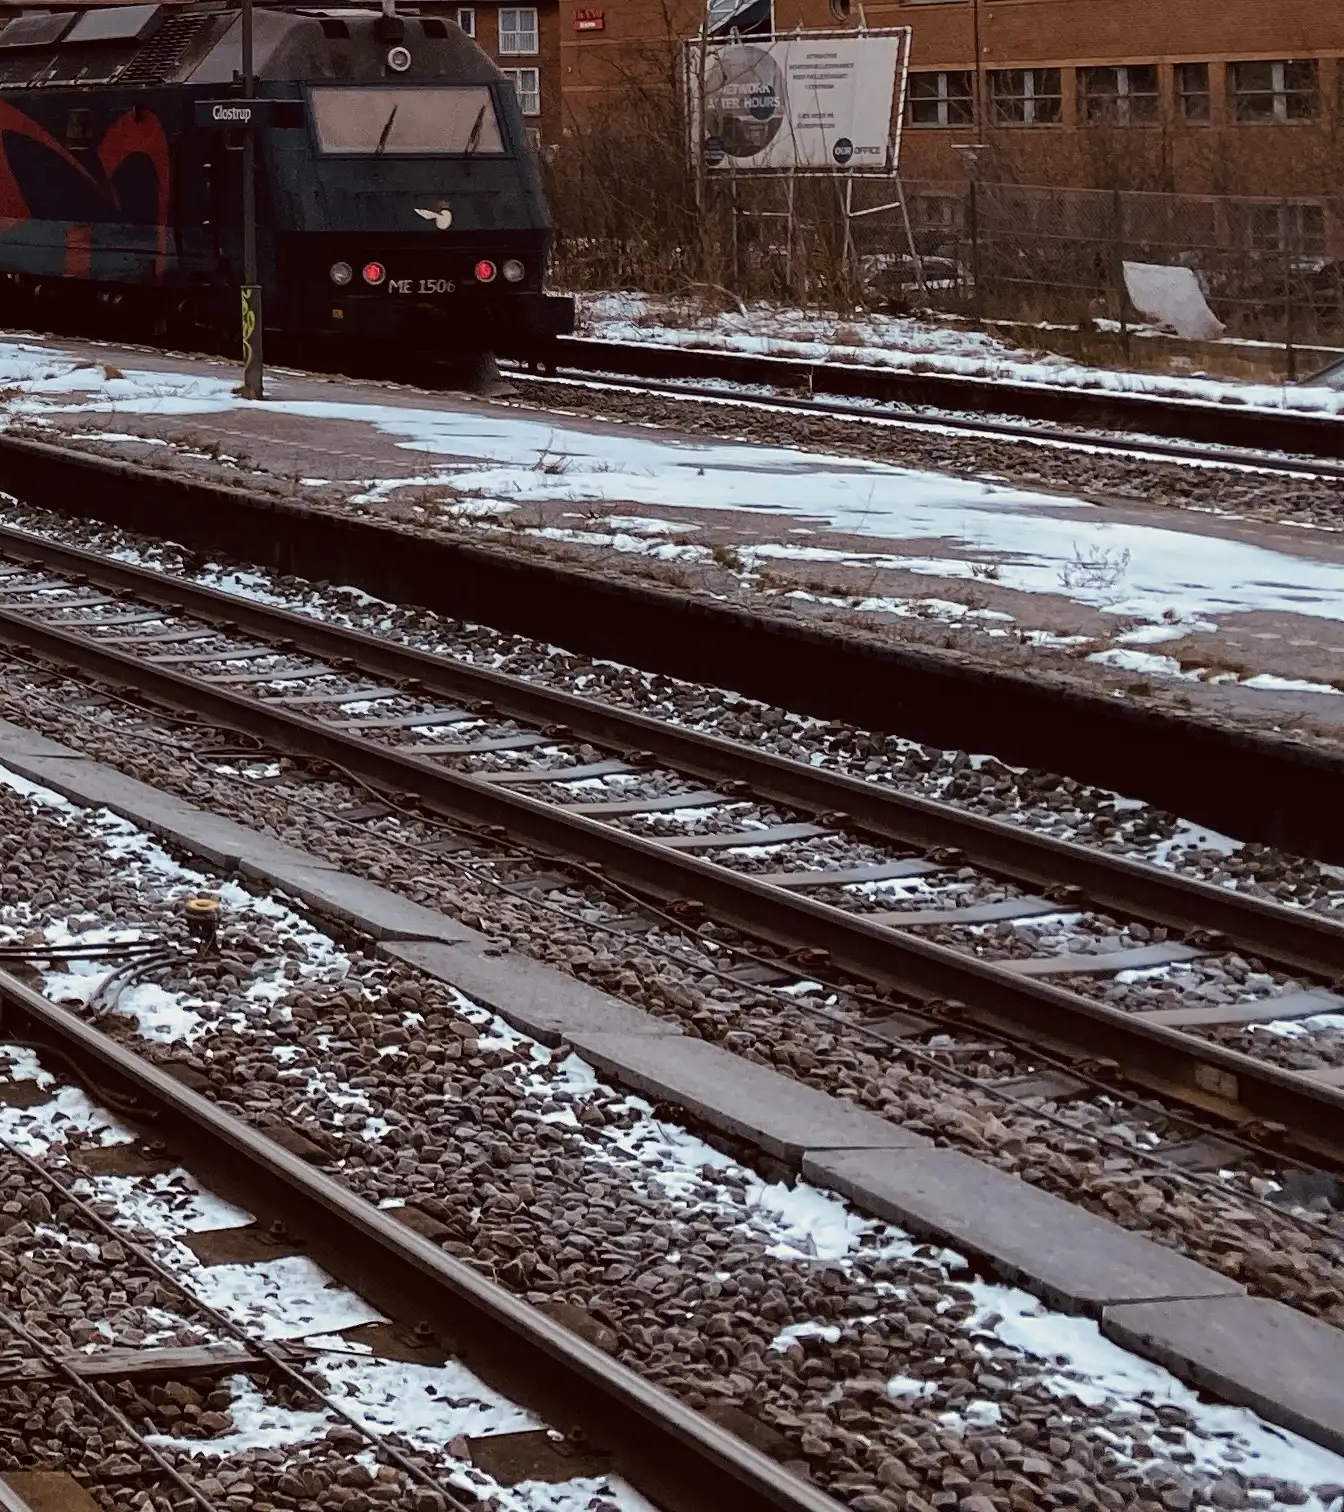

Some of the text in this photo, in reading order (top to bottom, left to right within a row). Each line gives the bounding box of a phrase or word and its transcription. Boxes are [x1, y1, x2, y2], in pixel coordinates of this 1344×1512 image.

[708, 96, 781, 109] ATER HOURS
[212, 105, 251, 123] Glostrup
[854, 146, 881, 155] OFFICE
[388, 279, 456, 293] ME 1506
